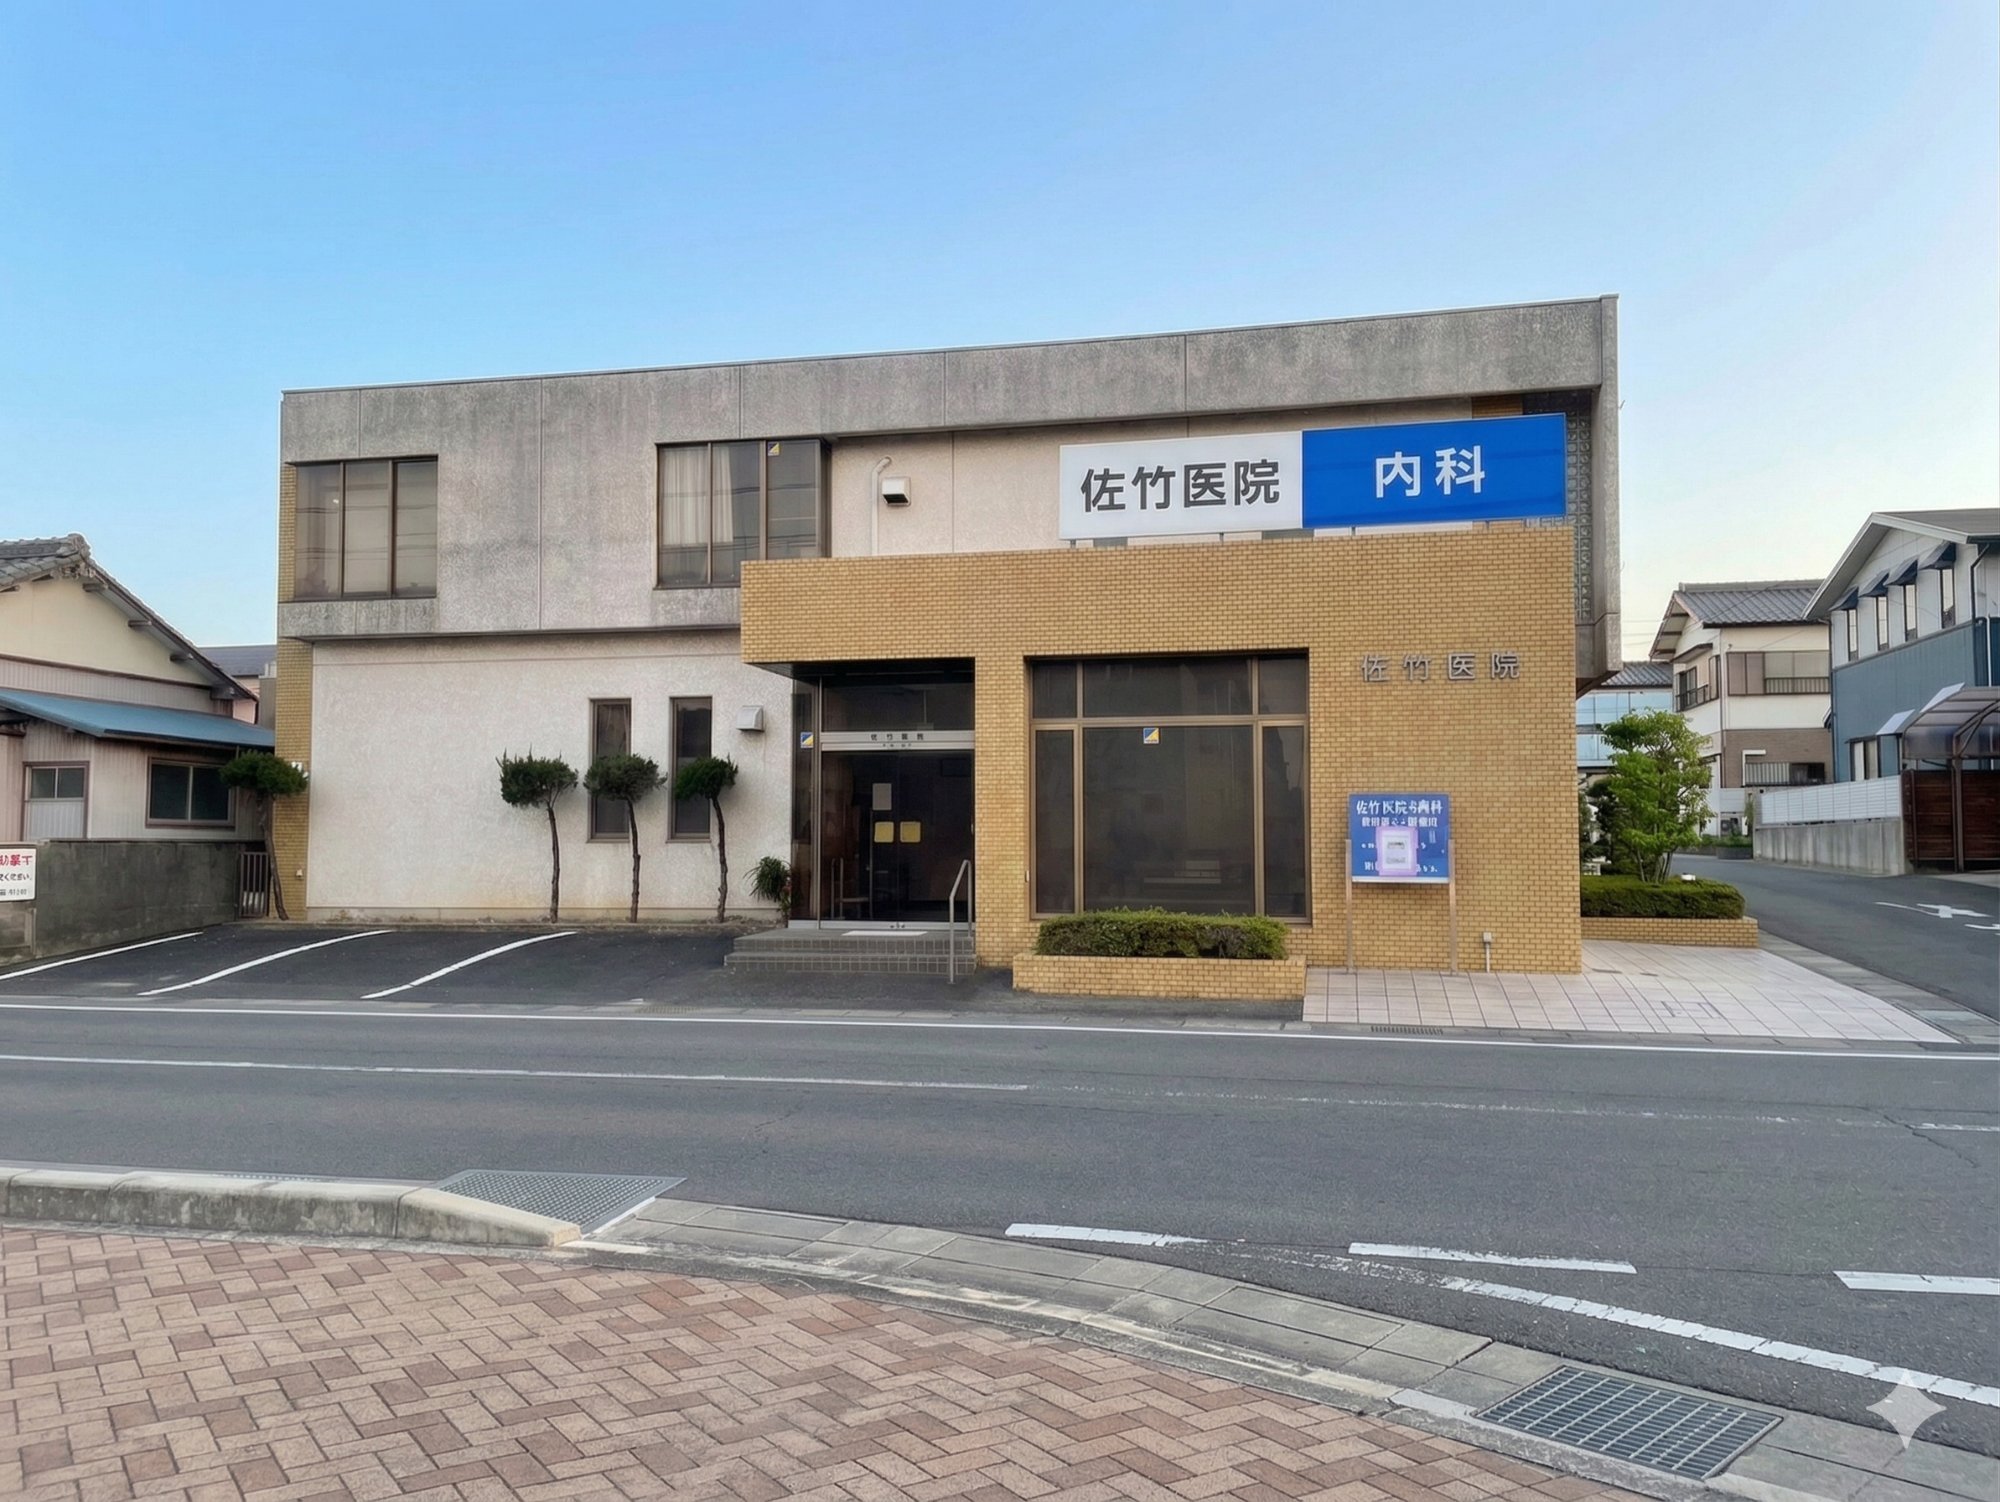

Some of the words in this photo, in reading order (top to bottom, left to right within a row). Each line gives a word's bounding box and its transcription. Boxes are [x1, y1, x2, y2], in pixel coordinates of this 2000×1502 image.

[1081, 459, 1281, 512] 佐竹医院
[1375, 445, 1486, 498] 内科
[1361, 651, 1520, 682] 佐竹医院
